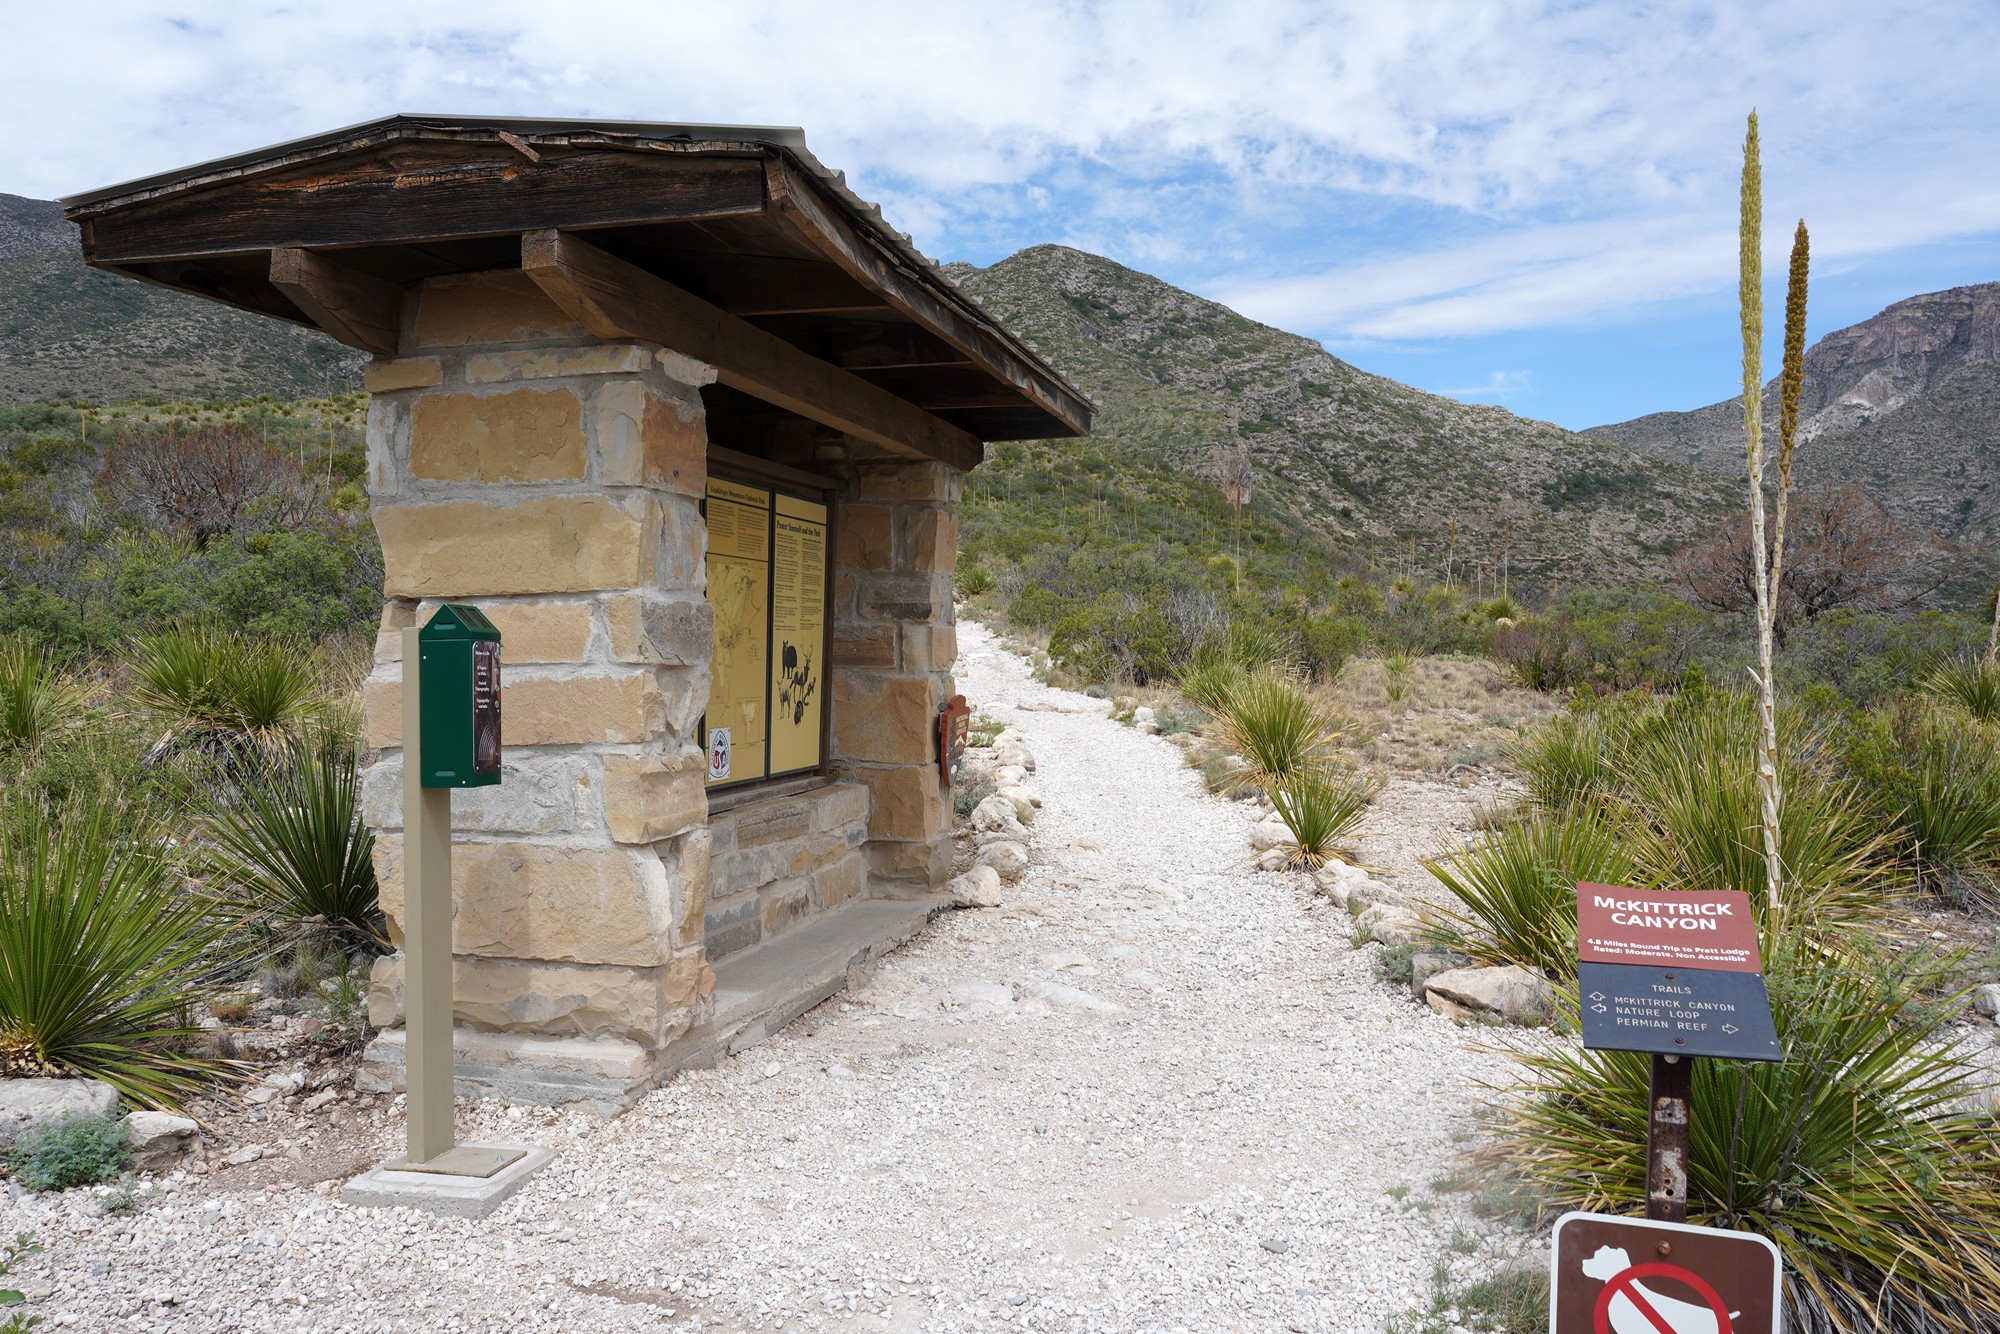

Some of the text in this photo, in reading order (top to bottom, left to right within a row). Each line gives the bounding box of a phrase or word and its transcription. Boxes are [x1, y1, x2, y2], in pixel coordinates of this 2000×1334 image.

[1593, 895, 1733, 915] McKITTRICK
[1611, 913, 1717, 930] CANYON
[1593, 946, 1623, 954] Rated:
[1625, 948, 1674, 958] Moderate,
[1699, 954, 1747, 962] Accessible
[1603, 940, 1628, 948] Miles
[1630, 942, 1660, 951] Round
[1662, 945, 1680, 953] Trip
[1720, 948, 1751, 956] Lodge
[1651, 984, 1692, 995] TRAILS
[1614, 996, 1736, 1012] McKITTRICK CANYON
[1615, 1006, 1701, 1020] NATURE LOOP
[1616, 1017, 1709, 1032] PERMIAN REEF
